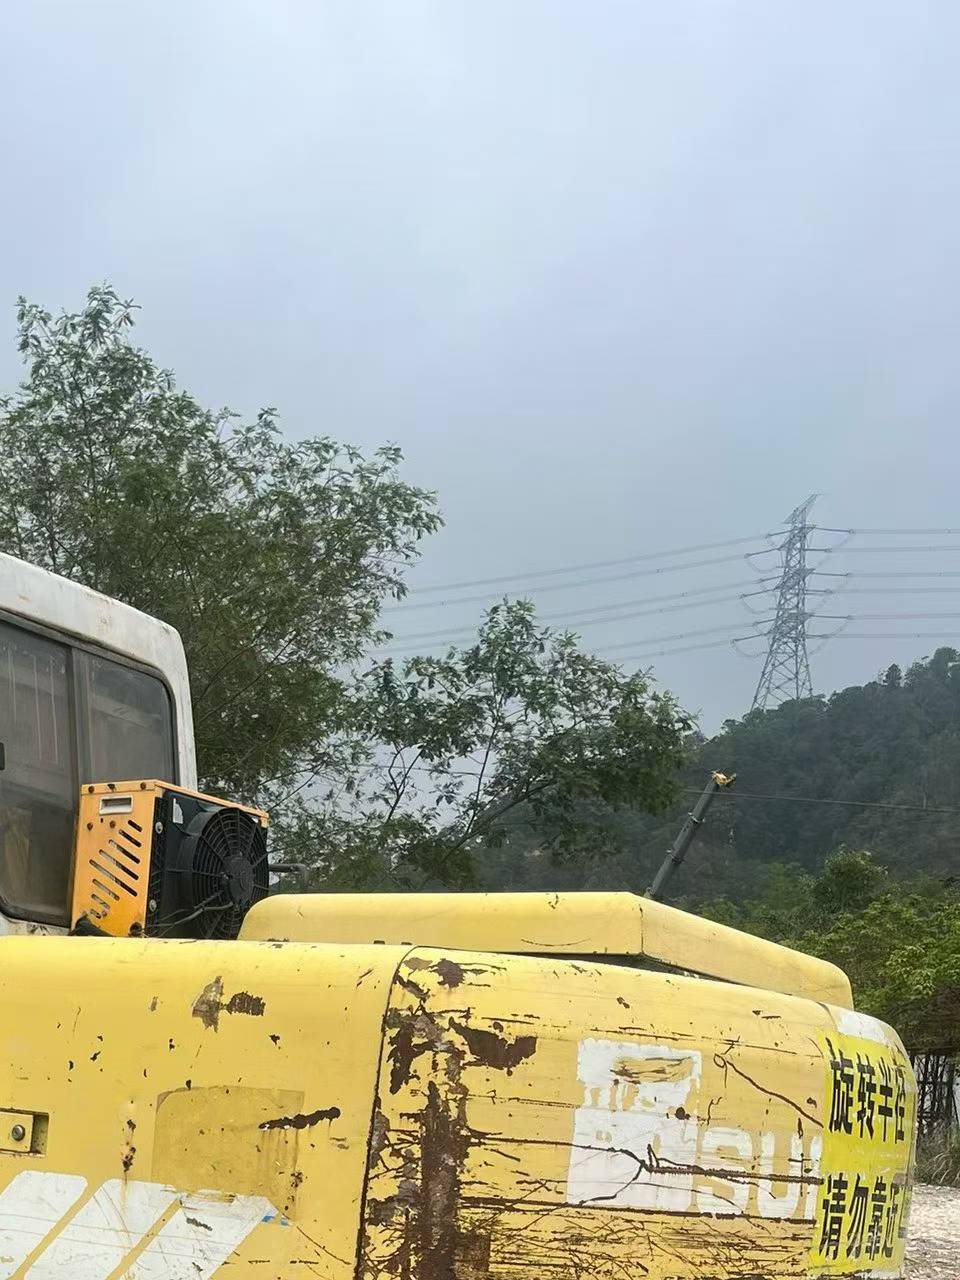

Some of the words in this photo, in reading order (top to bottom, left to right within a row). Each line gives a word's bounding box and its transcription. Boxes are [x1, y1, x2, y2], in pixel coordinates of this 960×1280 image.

[825, 1037, 906, 1144] 旋转半径
[818, 1172, 899, 1260] 请勿靠近
